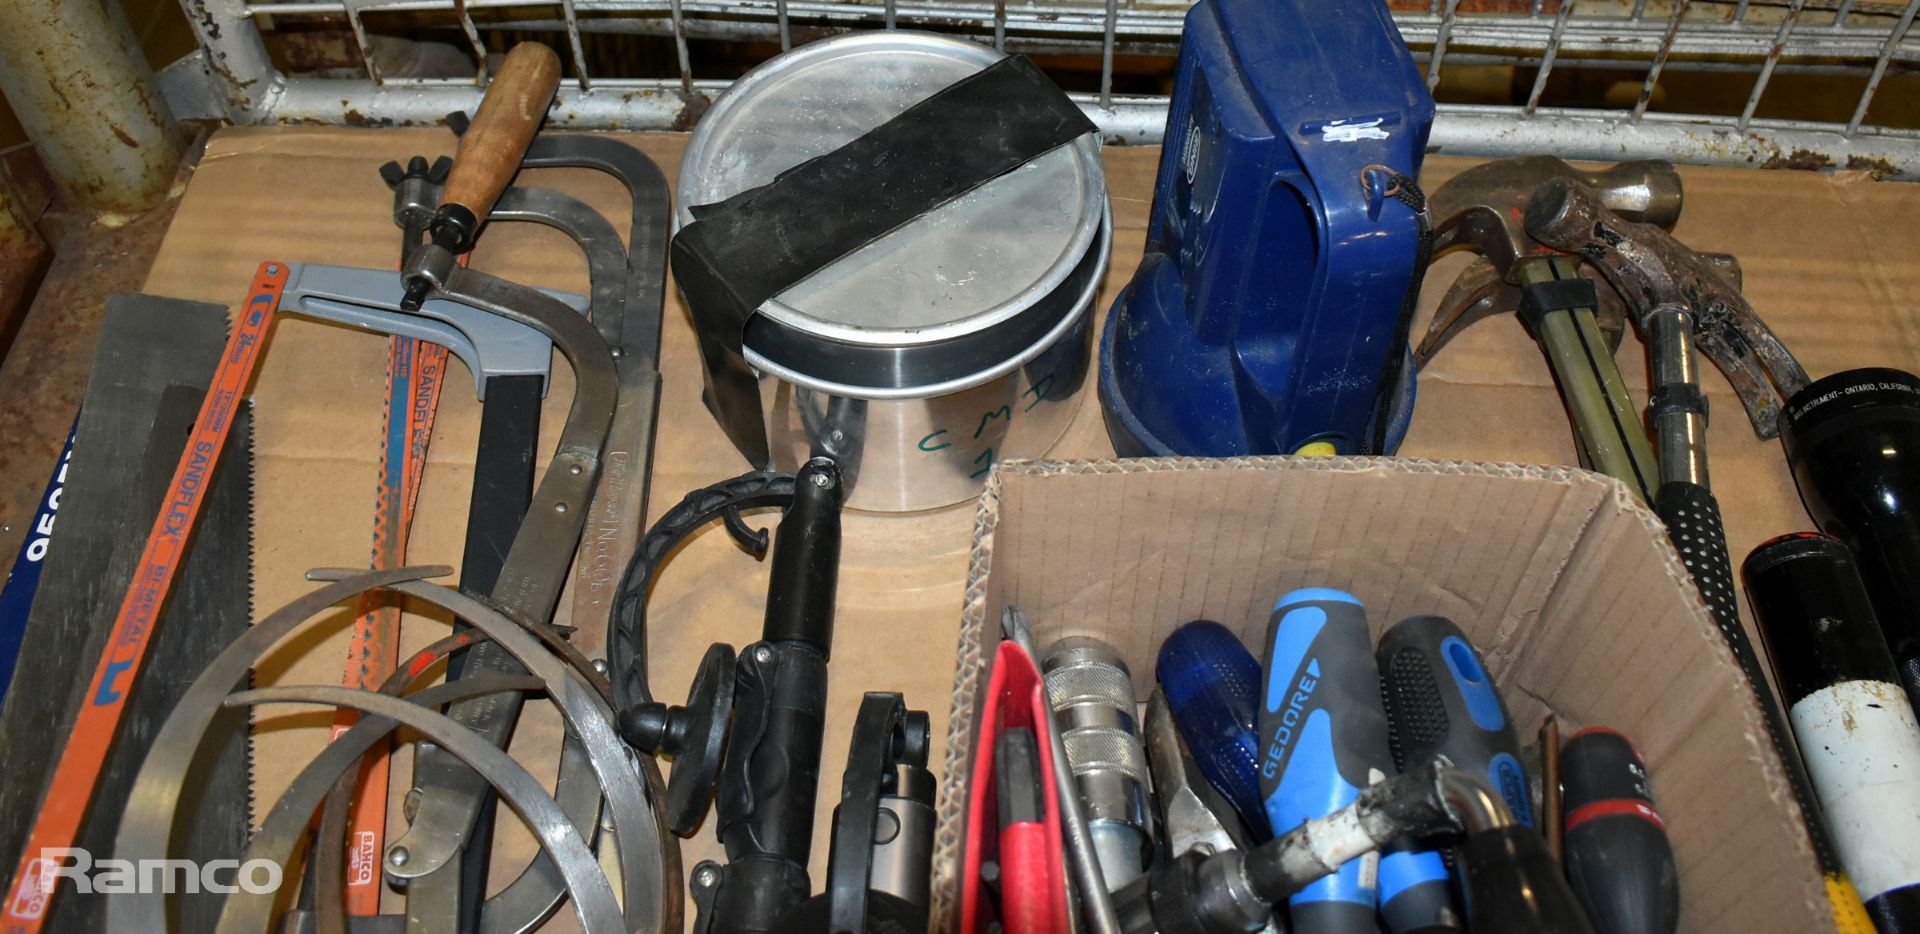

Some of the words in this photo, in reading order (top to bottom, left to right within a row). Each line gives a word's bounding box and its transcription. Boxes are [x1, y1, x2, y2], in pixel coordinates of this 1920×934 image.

[163, 440, 213, 537] SANDFLEX
[1263, 676, 1317, 780] GEDORE
[360, 834, 374, 881] BAHCO
